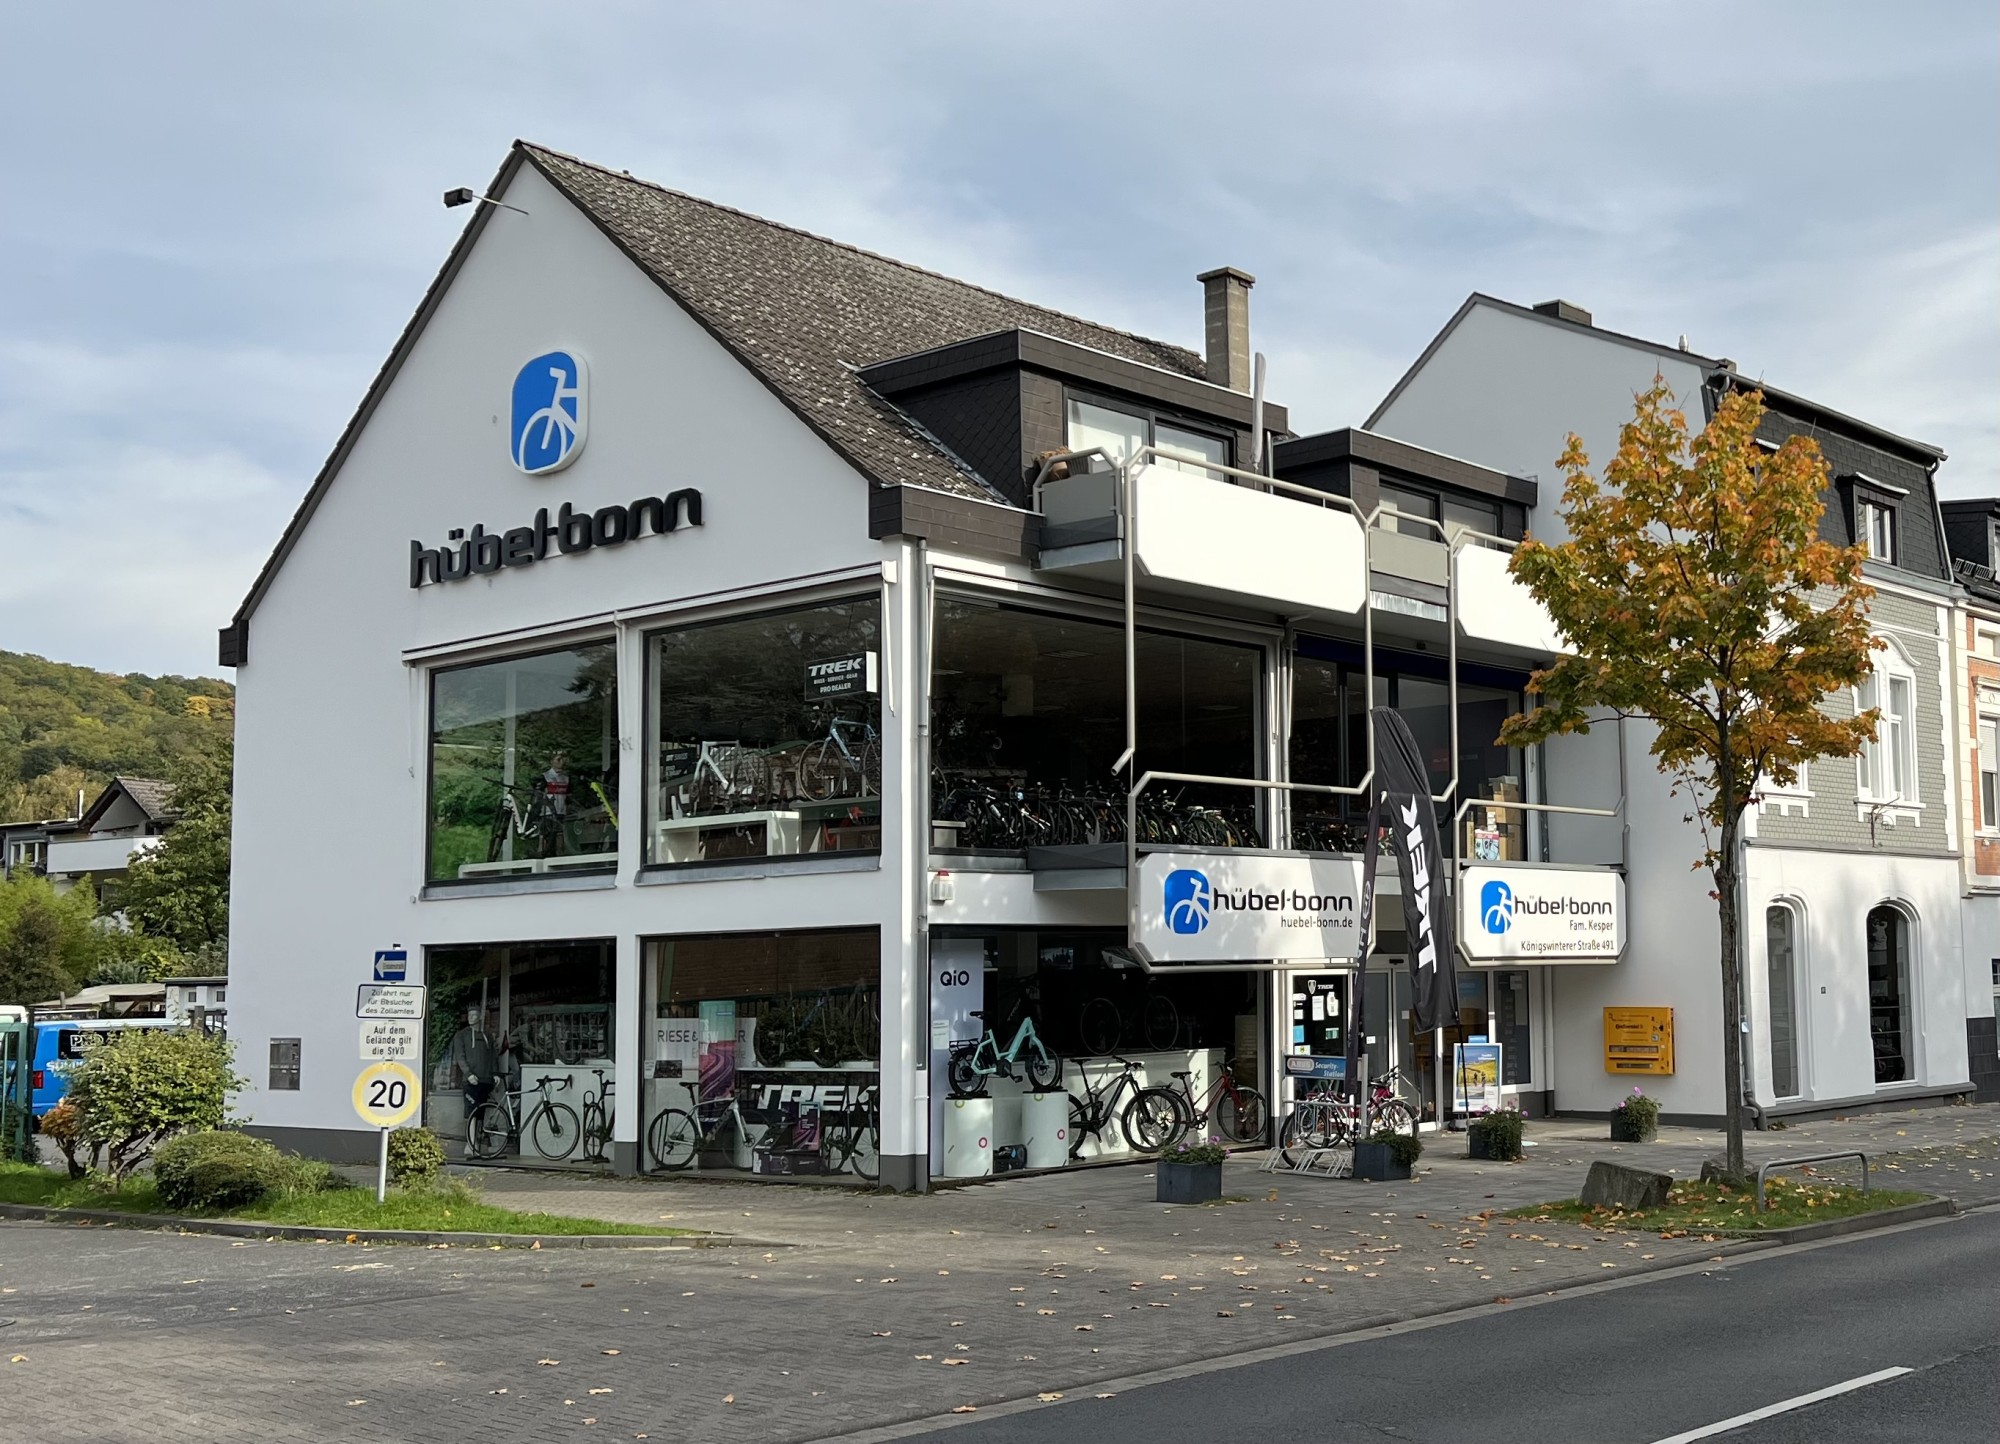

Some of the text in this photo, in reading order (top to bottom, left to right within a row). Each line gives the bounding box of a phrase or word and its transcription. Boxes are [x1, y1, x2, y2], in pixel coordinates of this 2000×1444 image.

[808, 658, 863, 676] TREK
[820, 683, 851, 694] PRO DEALER
[1401, 793, 1438, 974] TREK
[1281, 915, 1353, 929] huebel-bonn.de
[1570, 919, 1614, 933] Fam. Kesper
[1520, 940, 1614, 954] Königswinterer Straße 491
[940, 970, 970, 987] QiO
[371, 989, 398, 998] Zufahrt
[367, 998, 379, 1006] für
[380, 1007, 415, 1015] Zollamtes
[373, 1025, 406, 1035] Auf dem
[365, 1035, 412, 1047] Gelände gilt
[657, 1030, 691, 1043] RIESE
[372, 1046, 405, 1056] die StVO
[1324, 1070, 1344, 1078] Station
[368, 1080, 407, 1109] 20
